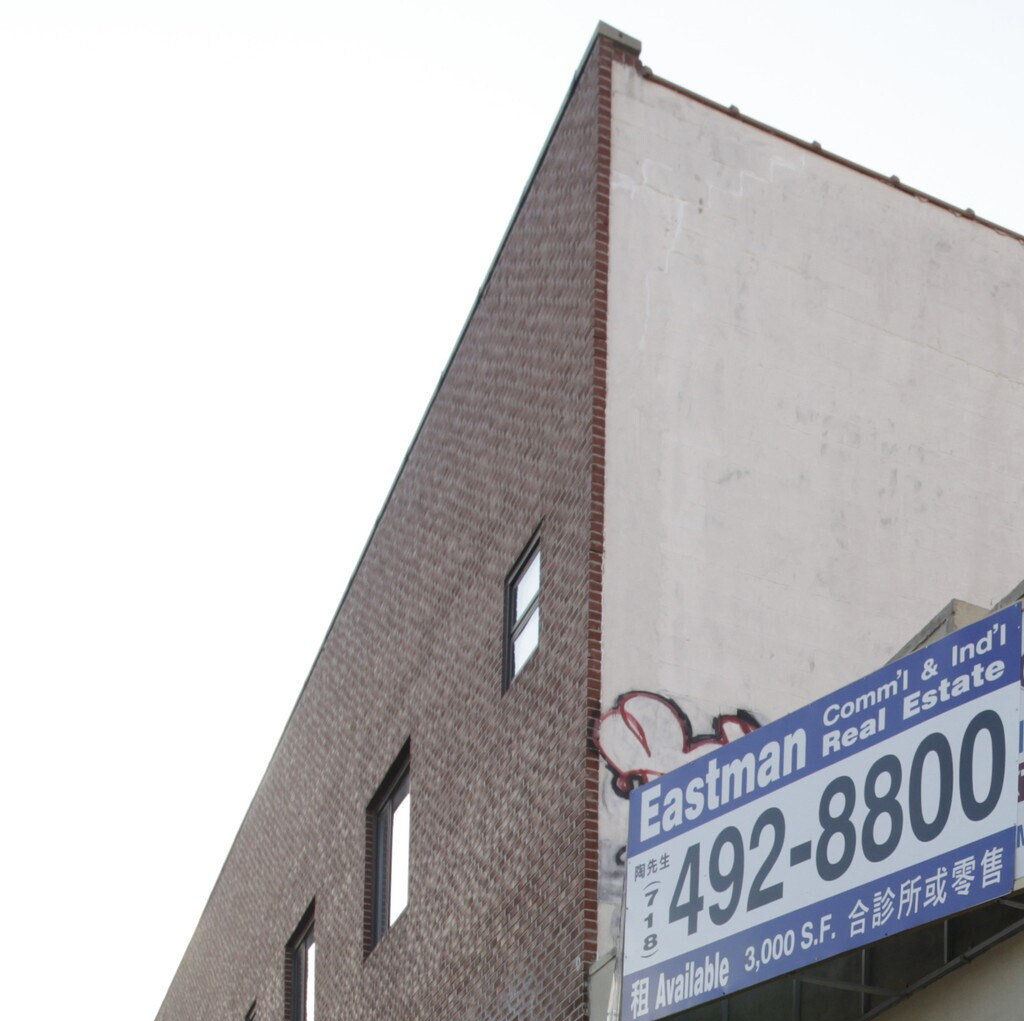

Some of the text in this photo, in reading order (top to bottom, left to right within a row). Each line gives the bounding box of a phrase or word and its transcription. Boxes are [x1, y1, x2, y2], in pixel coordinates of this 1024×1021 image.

[822, 707, 886, 758] Real
[903, 660, 1006, 721] Estate
[921, 658, 939, 681] &
[640, 727, 807, 842] Eastman
[667, 709, 1007, 937] 492-8800
[634, 852, 671, 882] 陶先生
[630, 846, 1004, 1020] 租 Available 3,000 S.F. 合診所或零售
